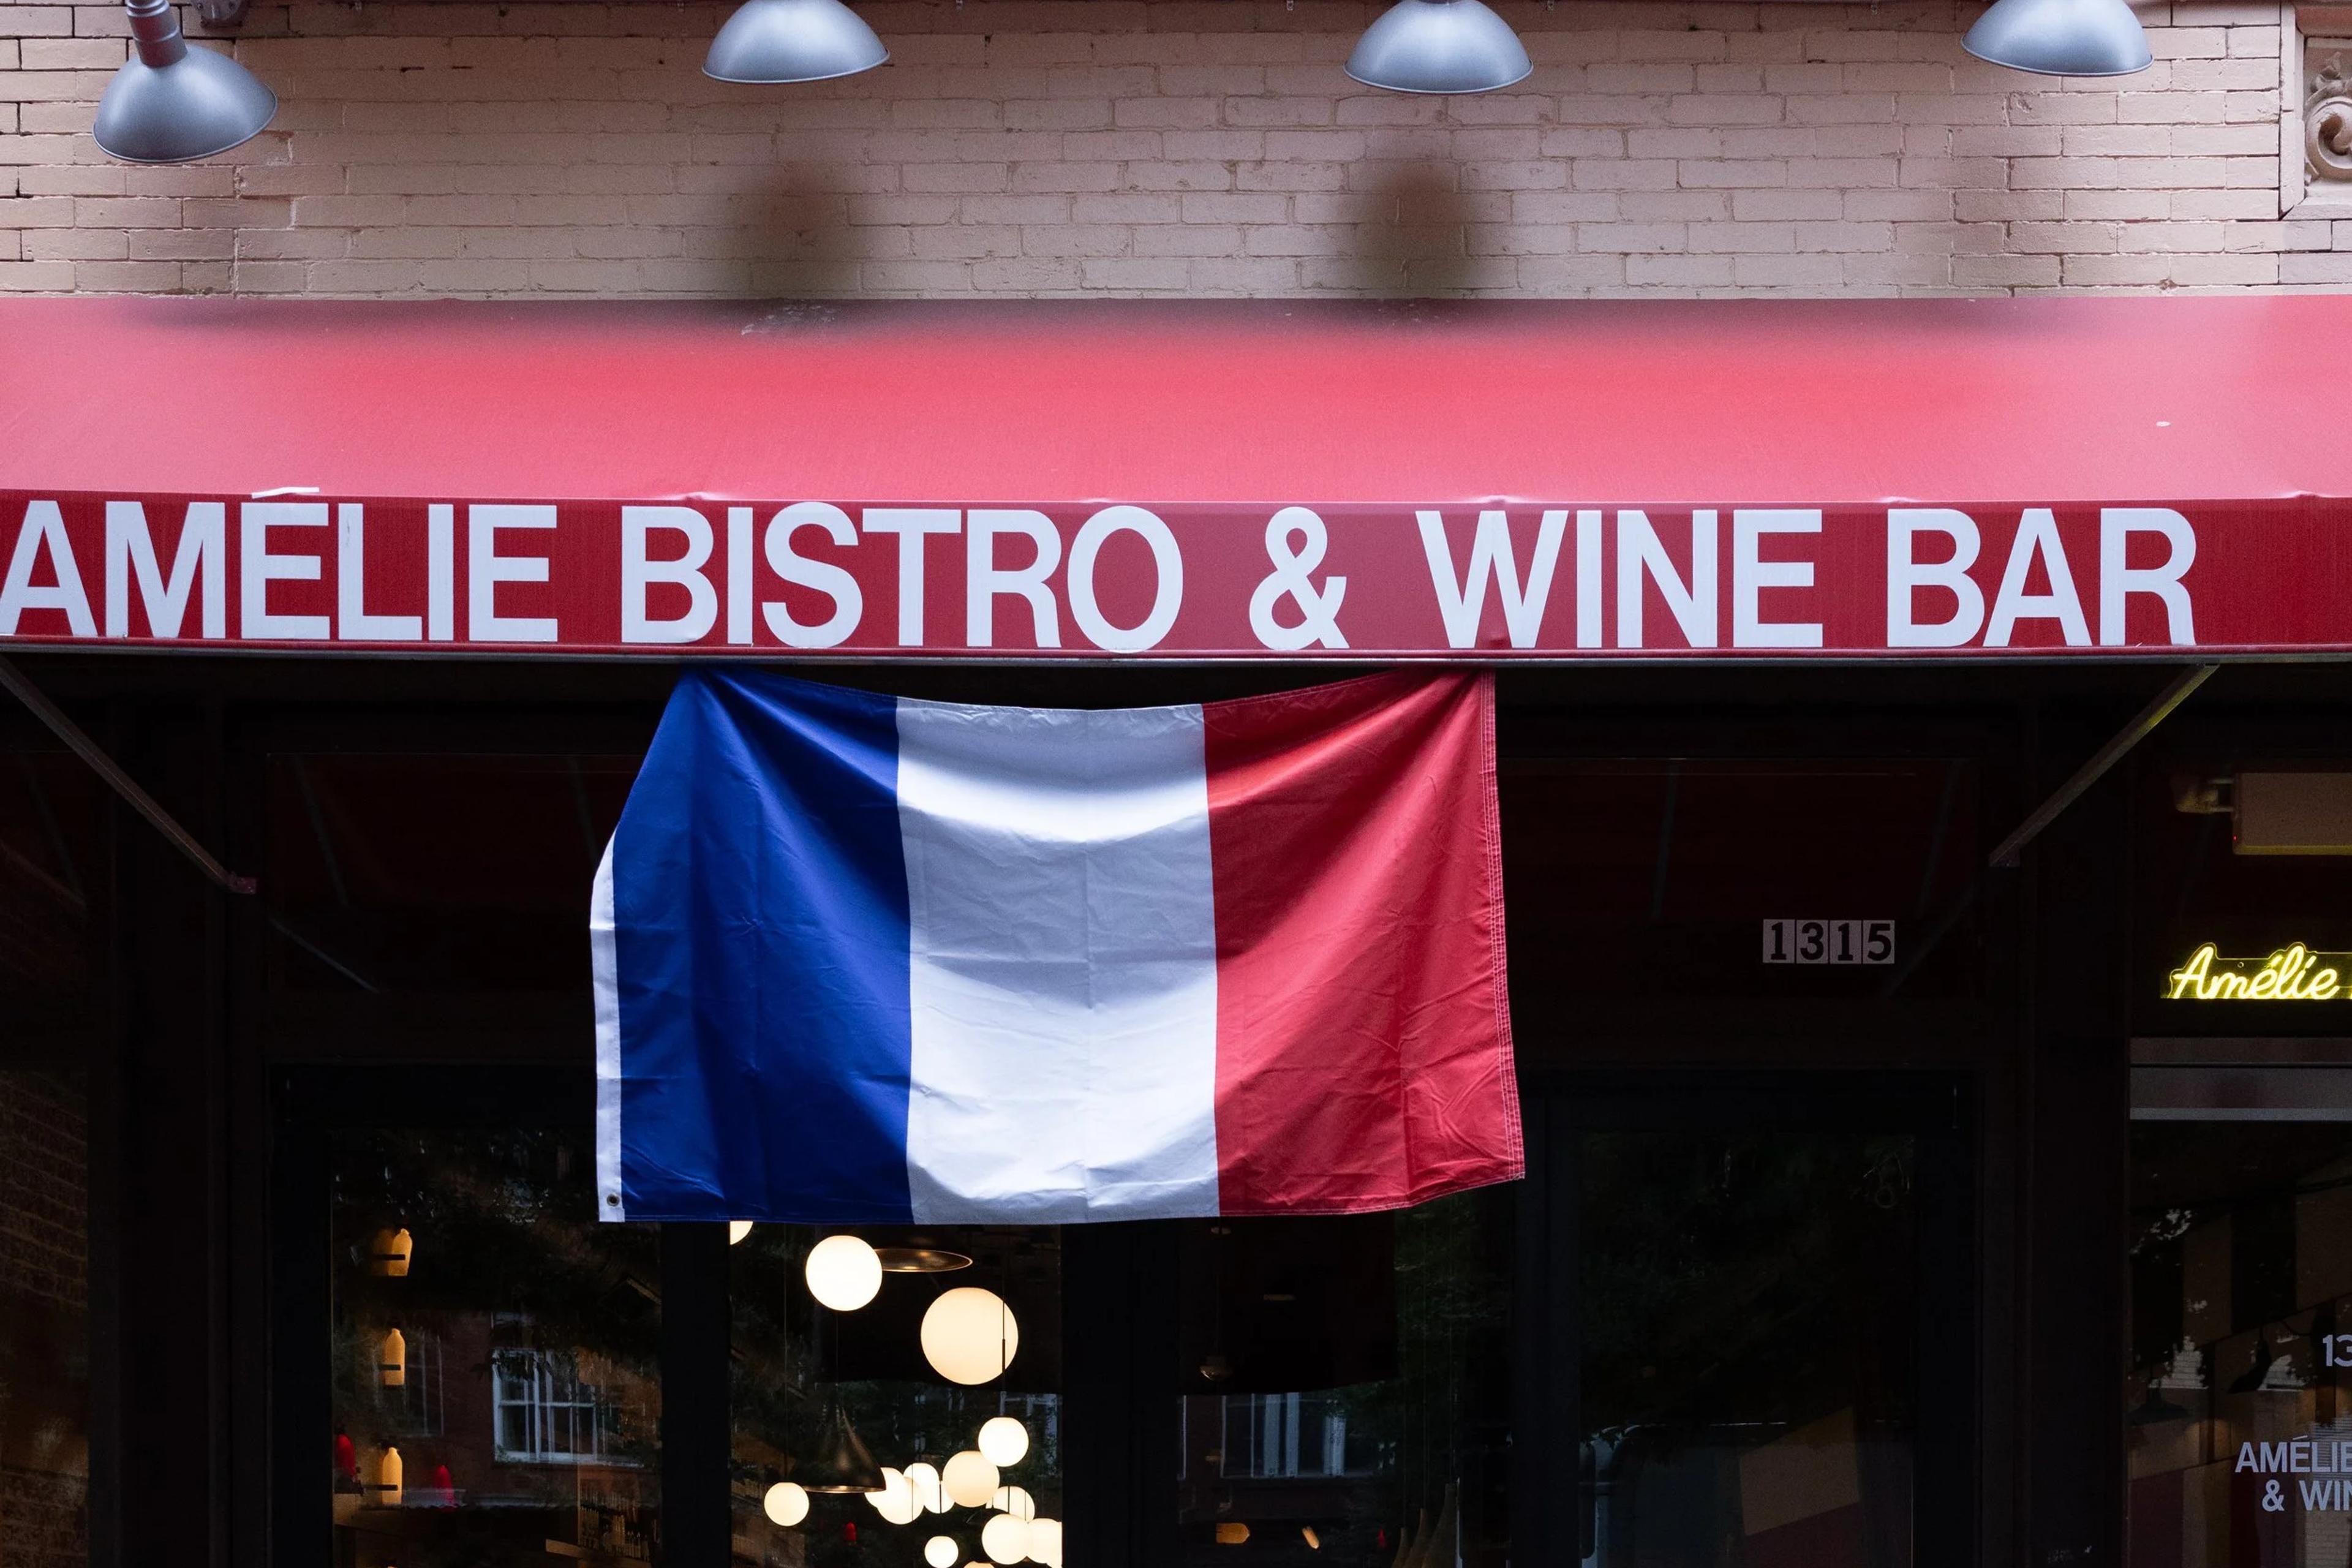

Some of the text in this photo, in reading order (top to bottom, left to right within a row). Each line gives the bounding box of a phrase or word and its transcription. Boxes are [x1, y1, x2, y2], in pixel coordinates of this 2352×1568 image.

[0, 486, 2196, 653] AMÉLIE BISTRO & WINE BAR
[1770, 921, 1892, 962] 1315
[2172, 946, 2340, 999] Amélie
[2322, 1334, 2352, 1366] 13
[2234, 1435, 2352, 1472] AMÉLIE
[2261, 1479, 2285, 1512] &
